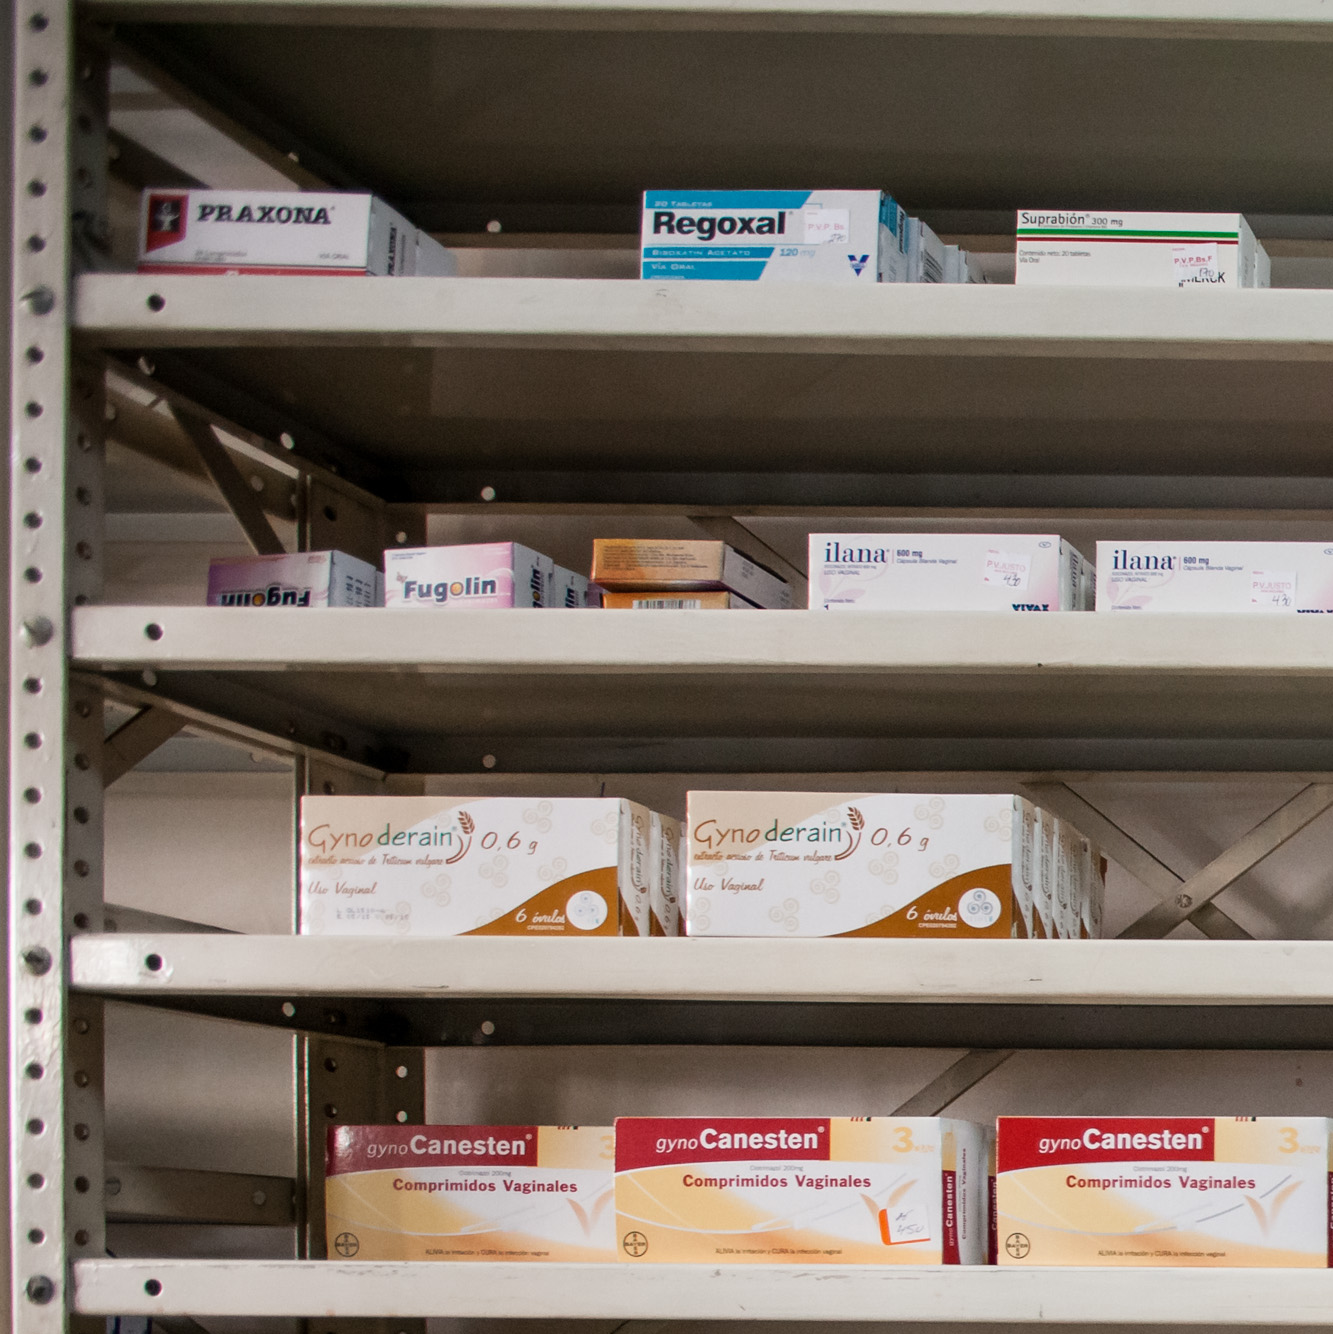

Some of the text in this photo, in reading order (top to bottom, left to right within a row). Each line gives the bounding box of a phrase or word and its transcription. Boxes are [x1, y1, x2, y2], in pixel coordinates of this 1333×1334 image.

[197, 205, 331, 224] PRAXONA
[1021, 212, 1085, 227] Suprabión
[1091, 217, 1107, 225] 300
[1111, 218, 1123, 227] mg
[653, 211, 785, 240] Regoxal
[780, 248, 815, 257] 120 mg
[824, 542, 887, 563] ilana
[1112, 550, 1174, 570] ilana
[404, 576, 497, 603] Fugolin
[481, 831, 521, 852] 0,6
[529, 841, 538, 855] g
[871, 827, 912, 849] 0,6
[919, 837, 929, 851] g
[308, 881, 378, 898] Uso Vaginal
[693, 878, 764, 893] Uso Vaginal
[515, 909, 527, 923] 6
[906, 905, 957, 922] 6 óvulos
[892, 1127, 914, 1153] 3
[1278, 1127, 1299, 1153] 3
[393, 1178, 578, 1194] Comprimidos Vaginales
[682, 1174, 871, 1190] Comprimidos Vaginales
[1066, 1175, 1256, 1191] Comprimidos Vaginales
